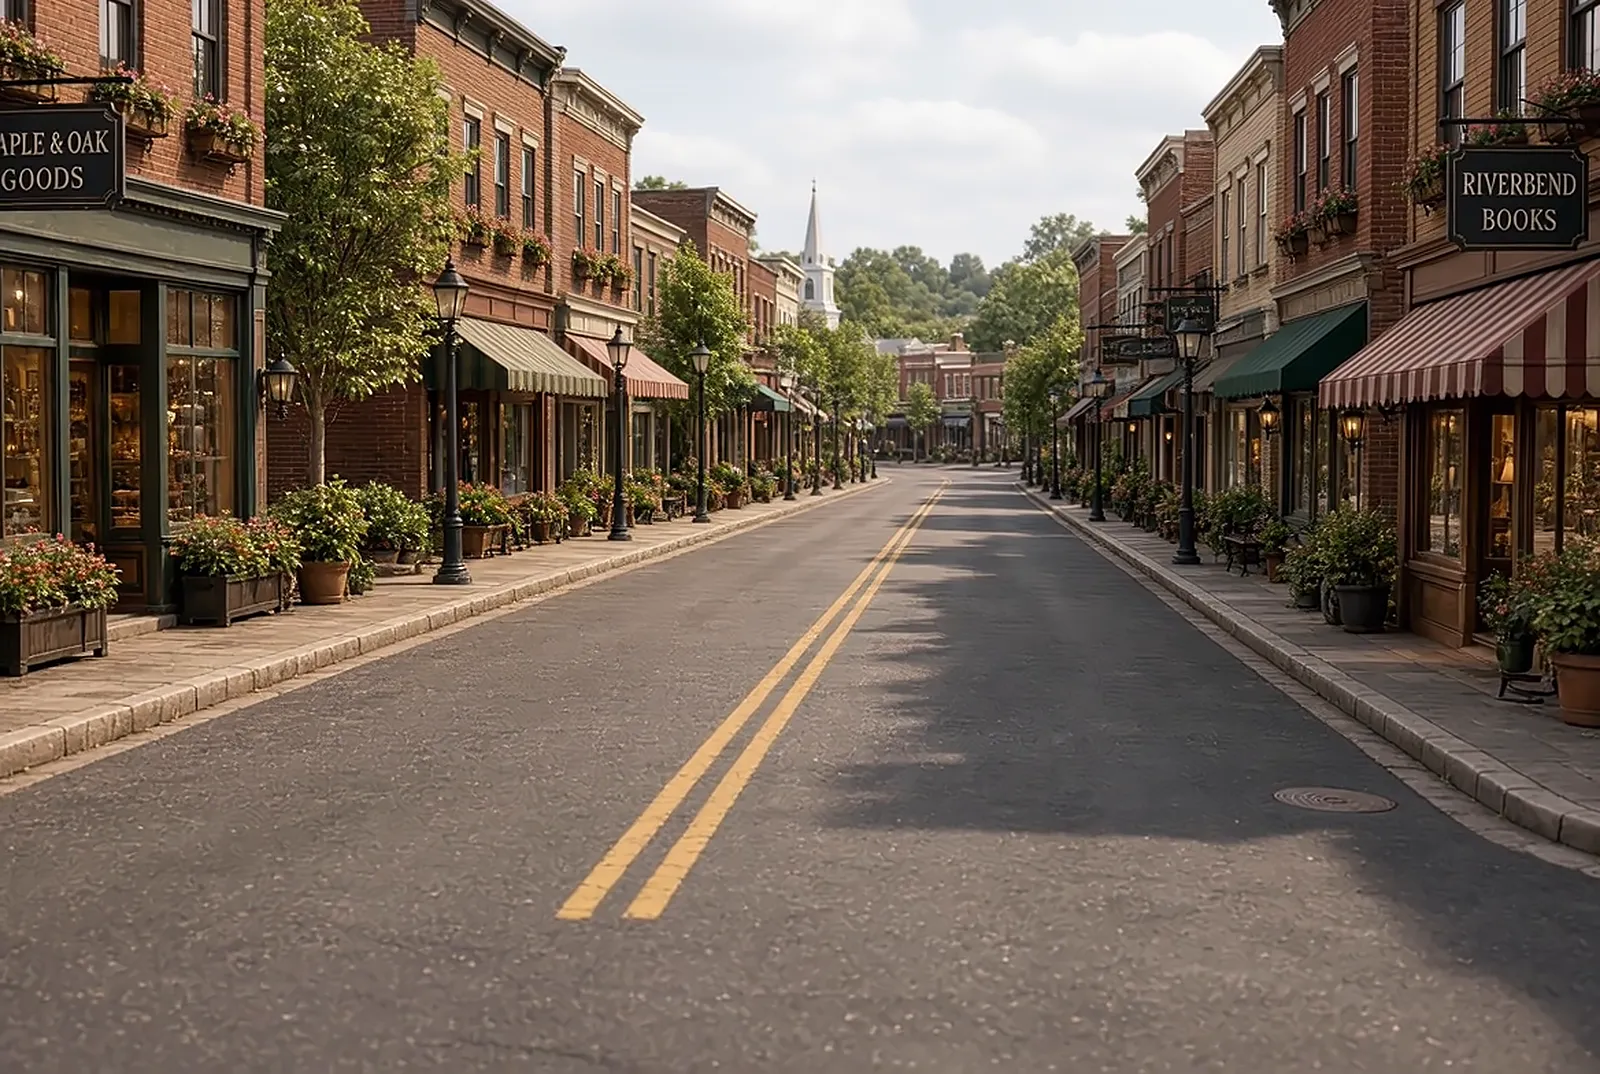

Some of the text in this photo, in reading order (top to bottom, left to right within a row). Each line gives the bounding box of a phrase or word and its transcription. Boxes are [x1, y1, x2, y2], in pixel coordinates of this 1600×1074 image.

[49, 131, 64, 155] &
[67, 129, 109, 154] OAK
[1, 166, 84, 191] GOODS
[1462, 172, 1577, 196] RIVERBEND
[1482, 208, 1557, 231] BOOKS
